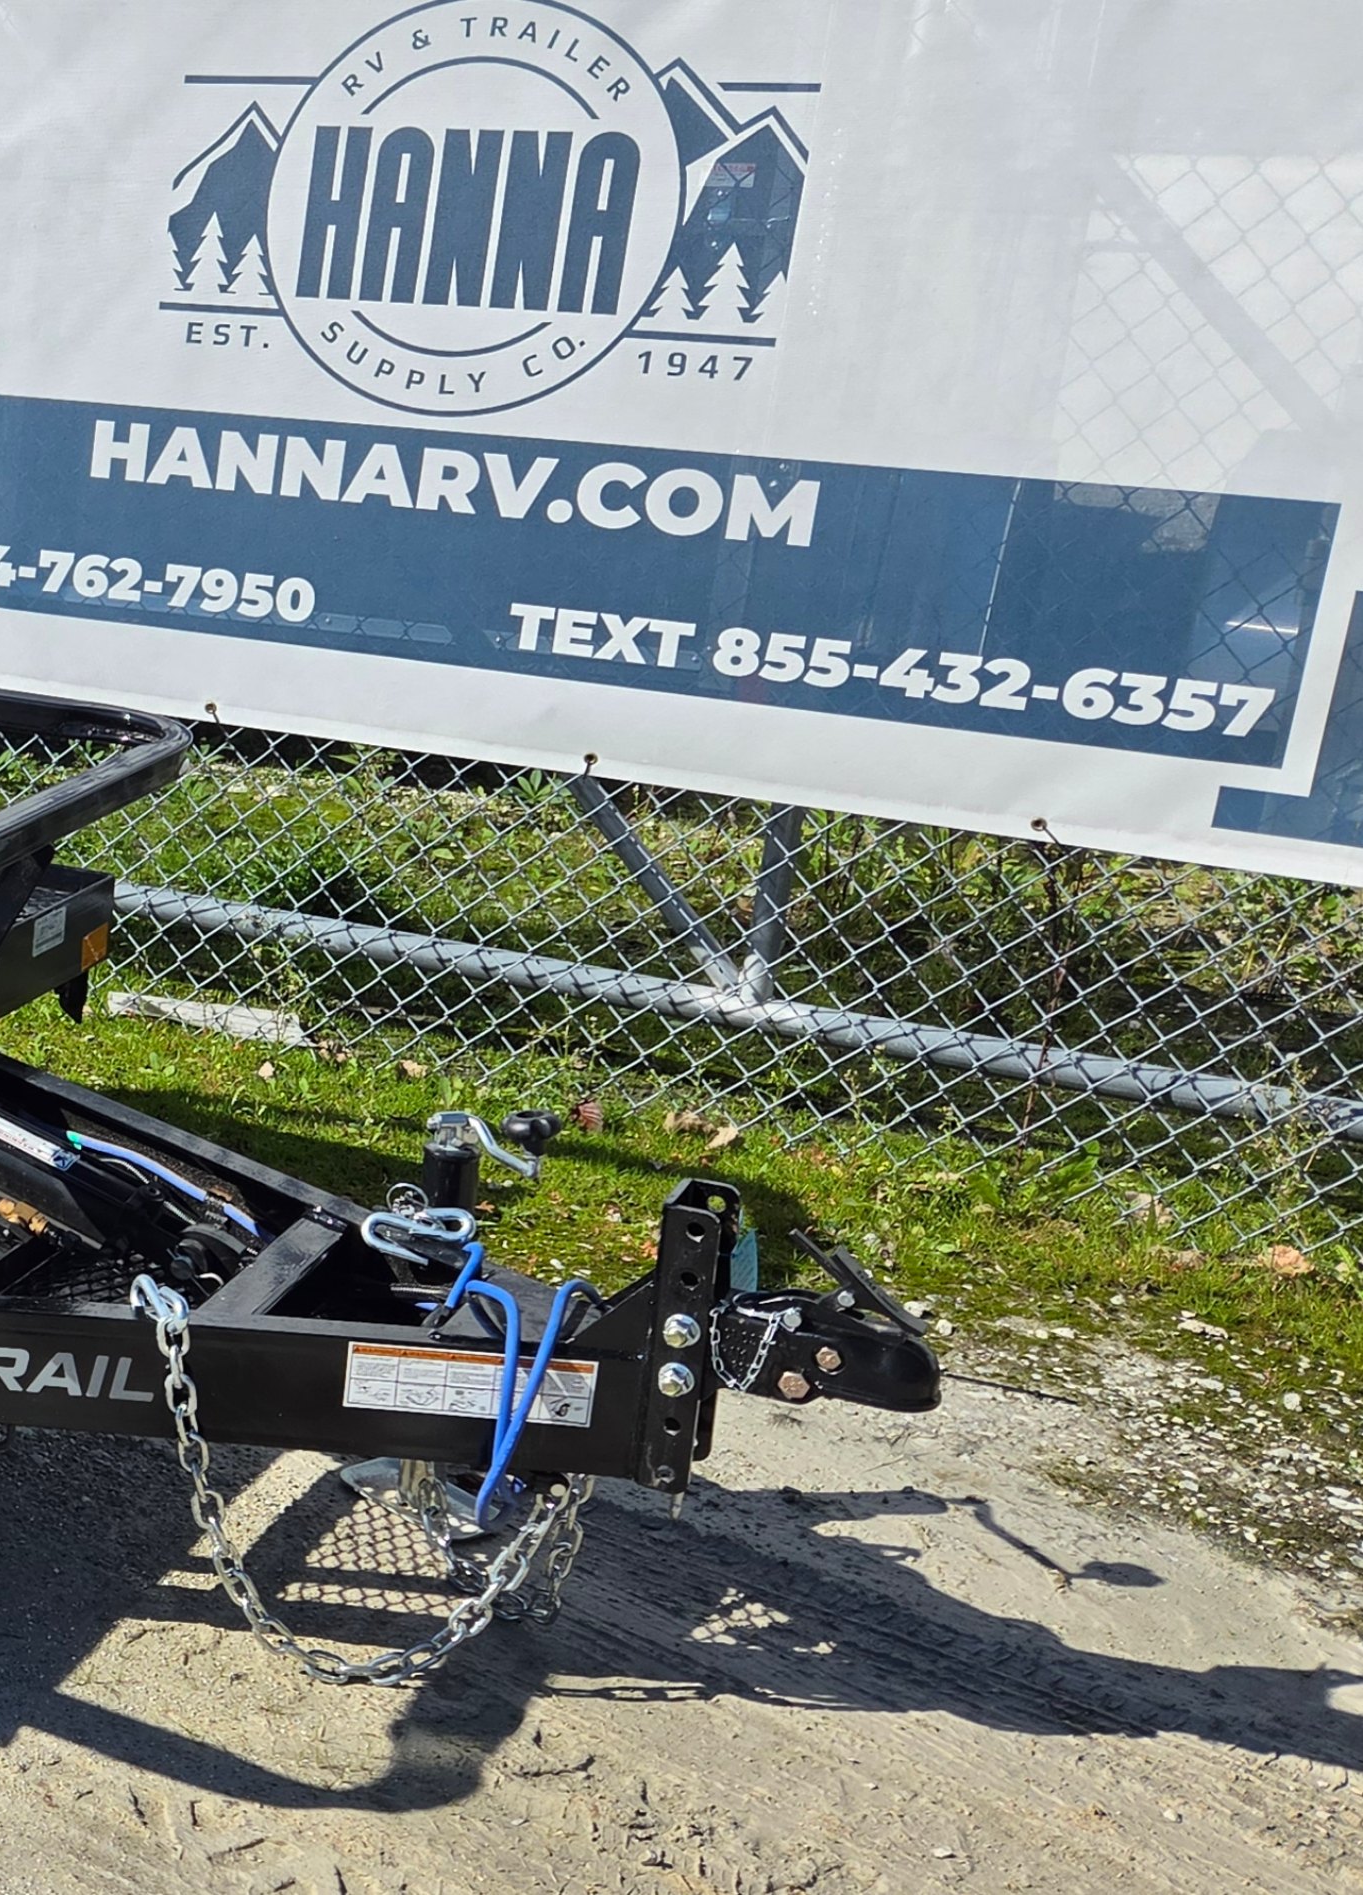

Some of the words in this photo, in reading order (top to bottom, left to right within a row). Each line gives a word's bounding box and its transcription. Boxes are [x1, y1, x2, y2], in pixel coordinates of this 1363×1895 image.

[341, 51, 386, 97] RV
[411, 29, 431, 50] &
[460, 16, 631, 102] TRAILER
[295, 125, 641, 316] HANNA
[185, 321, 270, 348] EST.
[320, 321, 488, 395] SUPPLY
[522, 336, 588, 378] CO.
[637, 350, 754, 381] 1947
[90, 419, 821, 547] HANNARV.COM
[510, 602, 697, 668] TEXT
[712, 627, 1276, 737] 855-432-6357
